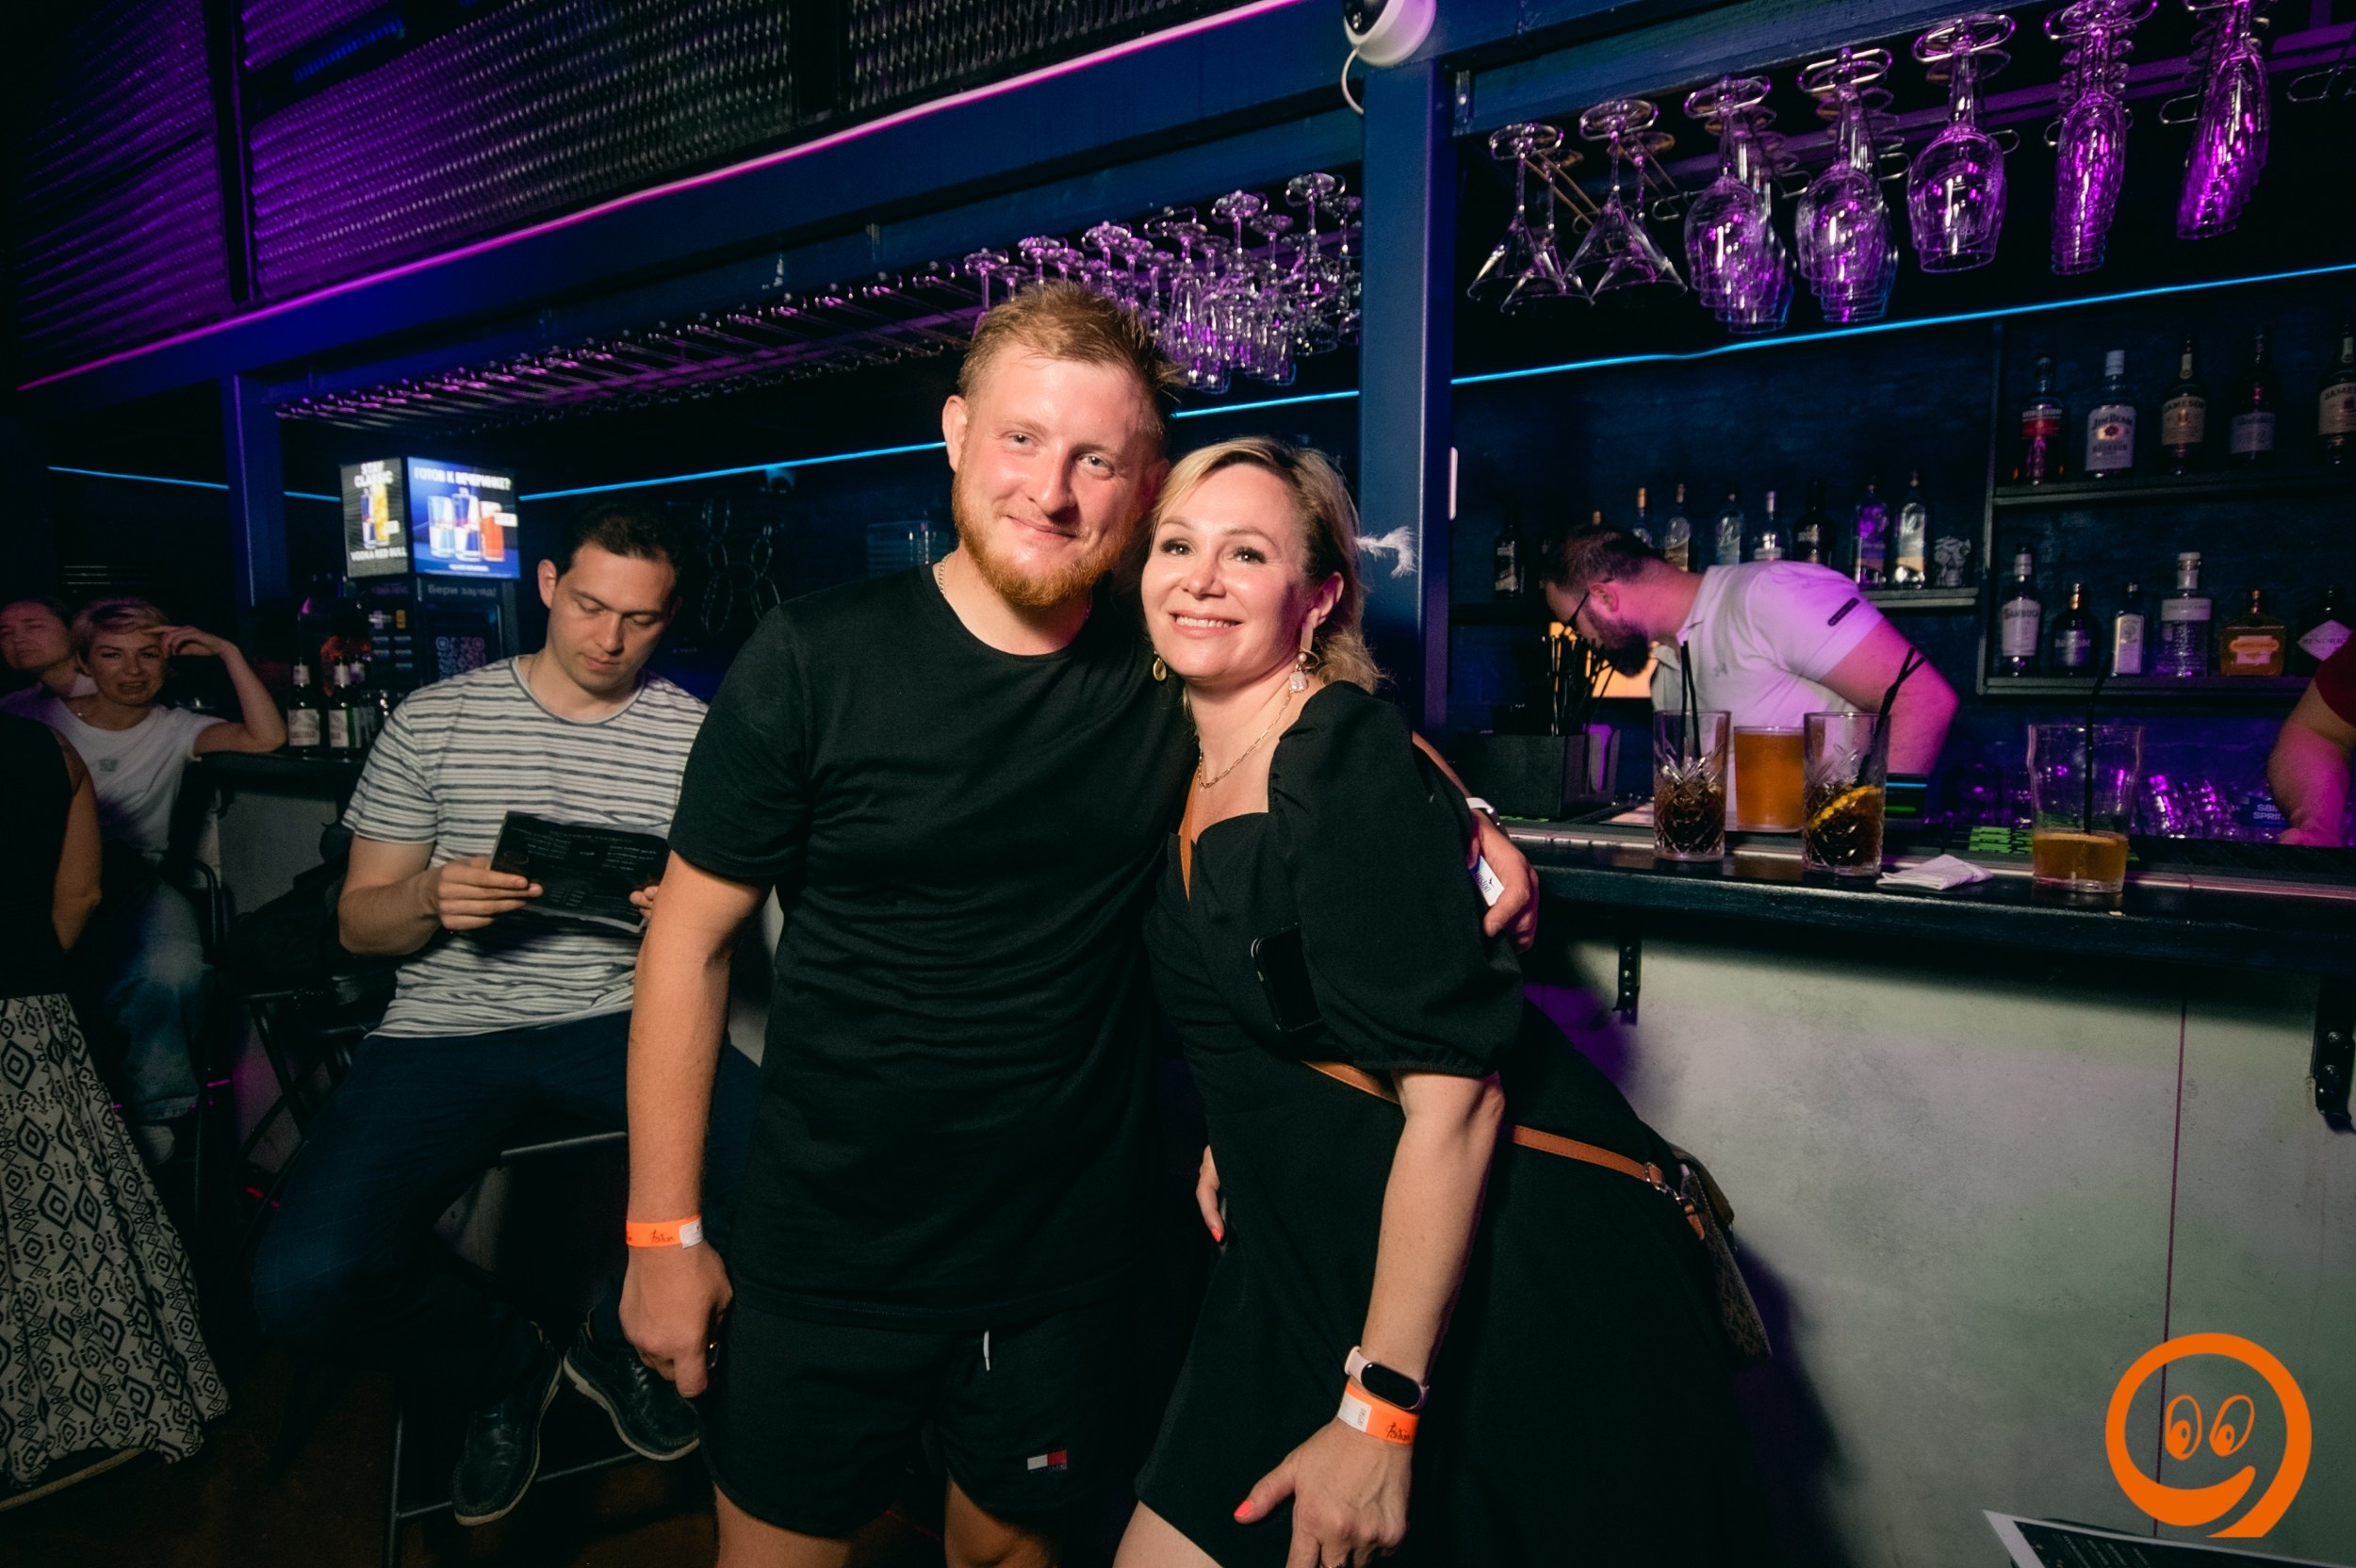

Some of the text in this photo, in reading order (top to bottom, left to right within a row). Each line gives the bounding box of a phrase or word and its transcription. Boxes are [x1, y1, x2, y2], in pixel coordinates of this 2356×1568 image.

[354, 470, 394, 488] CLASSIC
[414, 466, 446, 482] ГОТОВ
[375, 548, 388, 559] RED
[388, 547, 408, 558] BULL
[428, 583, 497, 596] Бери заряд!
